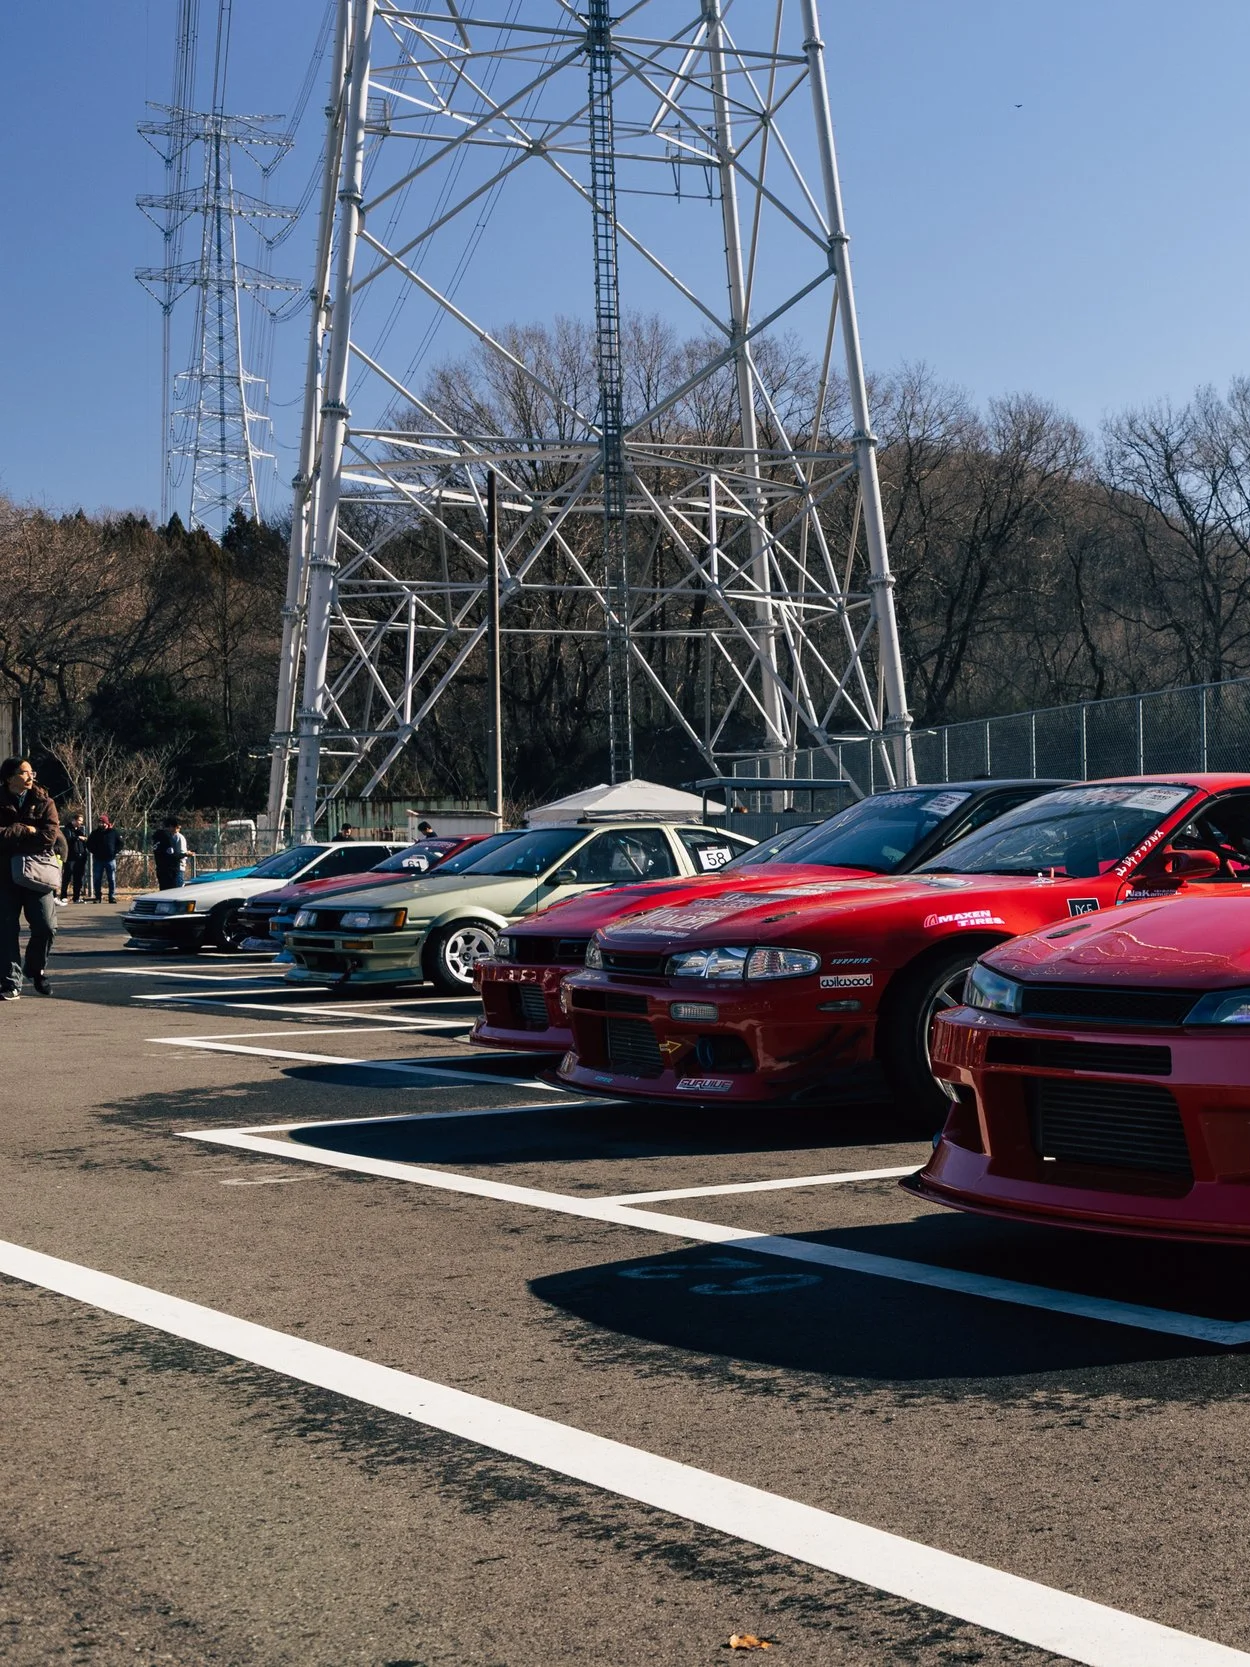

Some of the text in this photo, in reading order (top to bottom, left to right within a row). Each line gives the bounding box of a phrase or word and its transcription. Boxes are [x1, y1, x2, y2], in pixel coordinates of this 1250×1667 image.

[706, 852, 727, 867] 58
[938, 910, 991, 924] MAXEN
[957, 917, 1005, 927] TIRES
[821, 975, 872, 987] wilwood
